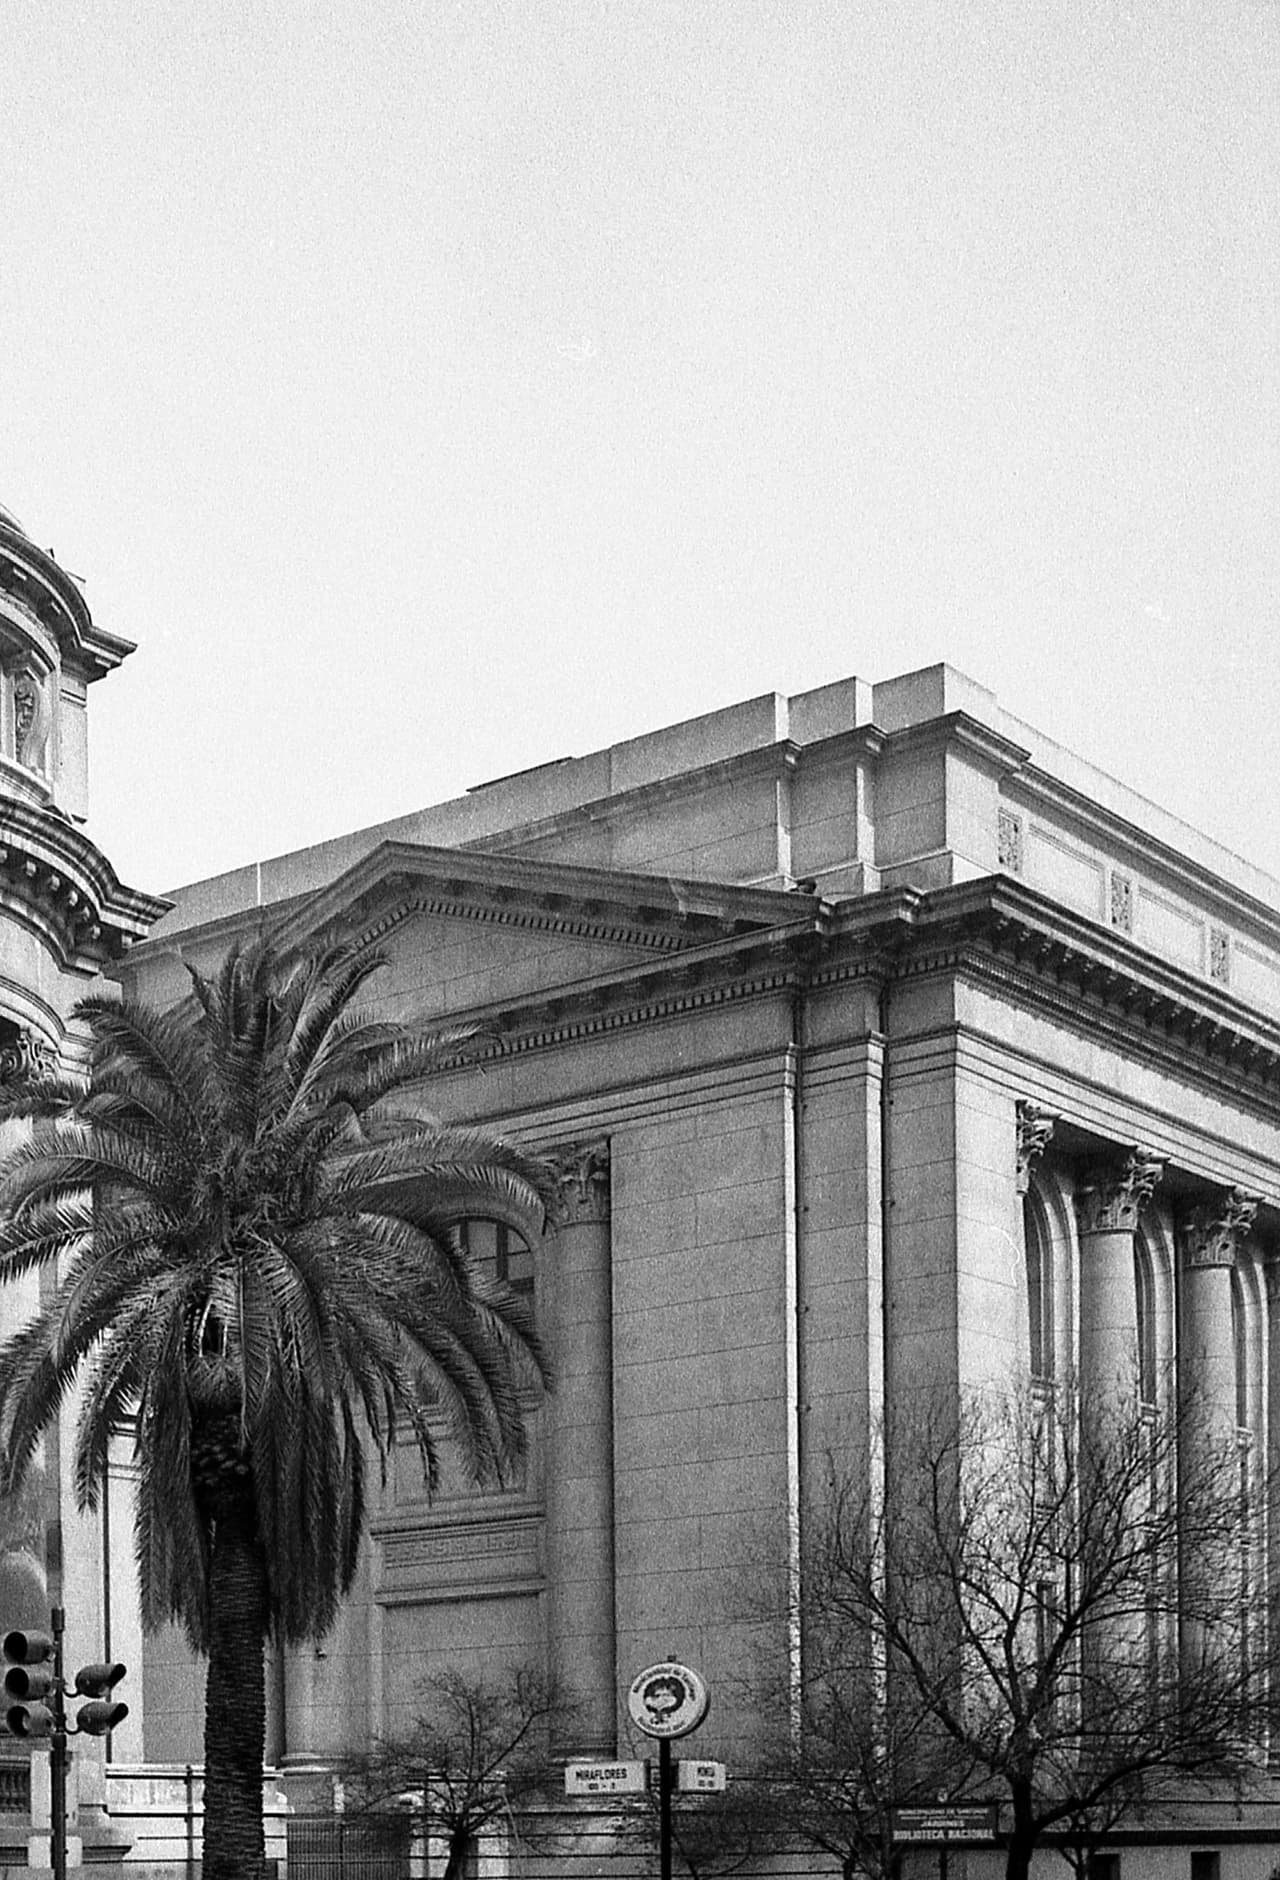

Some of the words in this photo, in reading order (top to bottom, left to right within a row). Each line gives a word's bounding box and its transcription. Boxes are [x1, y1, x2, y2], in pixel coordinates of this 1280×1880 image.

[575, 1768, 628, 1781] MIRAFLORES
[893, 1829, 946, 1841] BIBLIOTECA
[948, 1828, 997, 1840] NACIONAL
